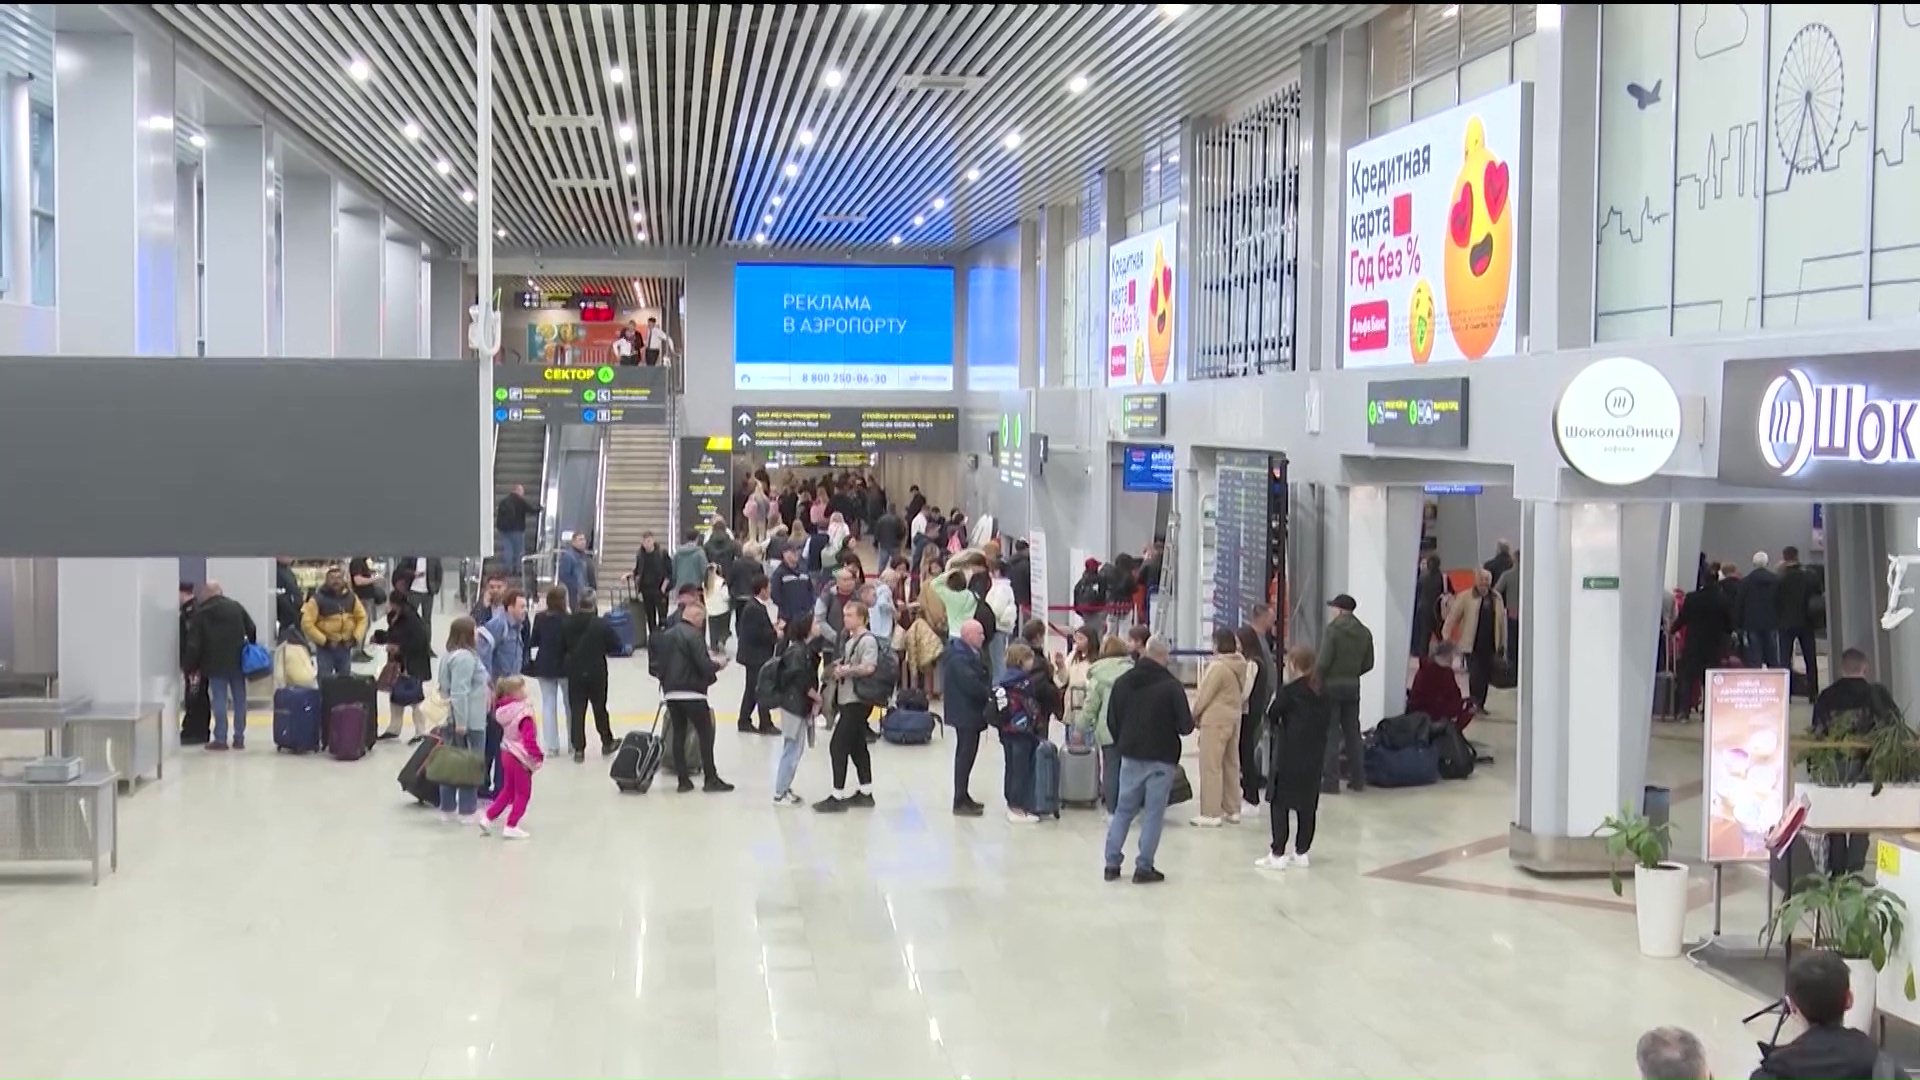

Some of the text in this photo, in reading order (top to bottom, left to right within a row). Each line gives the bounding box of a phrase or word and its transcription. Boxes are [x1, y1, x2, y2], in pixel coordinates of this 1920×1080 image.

[1351, 143, 1431, 205] Кредитная
[1351, 205, 1391, 248] карта
[1350, 234, 1421, 291] Год без %
[783, 293, 872, 311] РЕКЛАМА
[783, 316, 907, 335] В АЭРОПОРТУ
[544, 368, 595, 380] СЕКТОР
[802, 373, 808, 383] 8
[811, 373, 830, 383] 800
[833, 373, 887, 384] 250-06-30
[1565, 424, 1674, 440] Шоколадница
[1812, 384, 1920, 464] Шок
